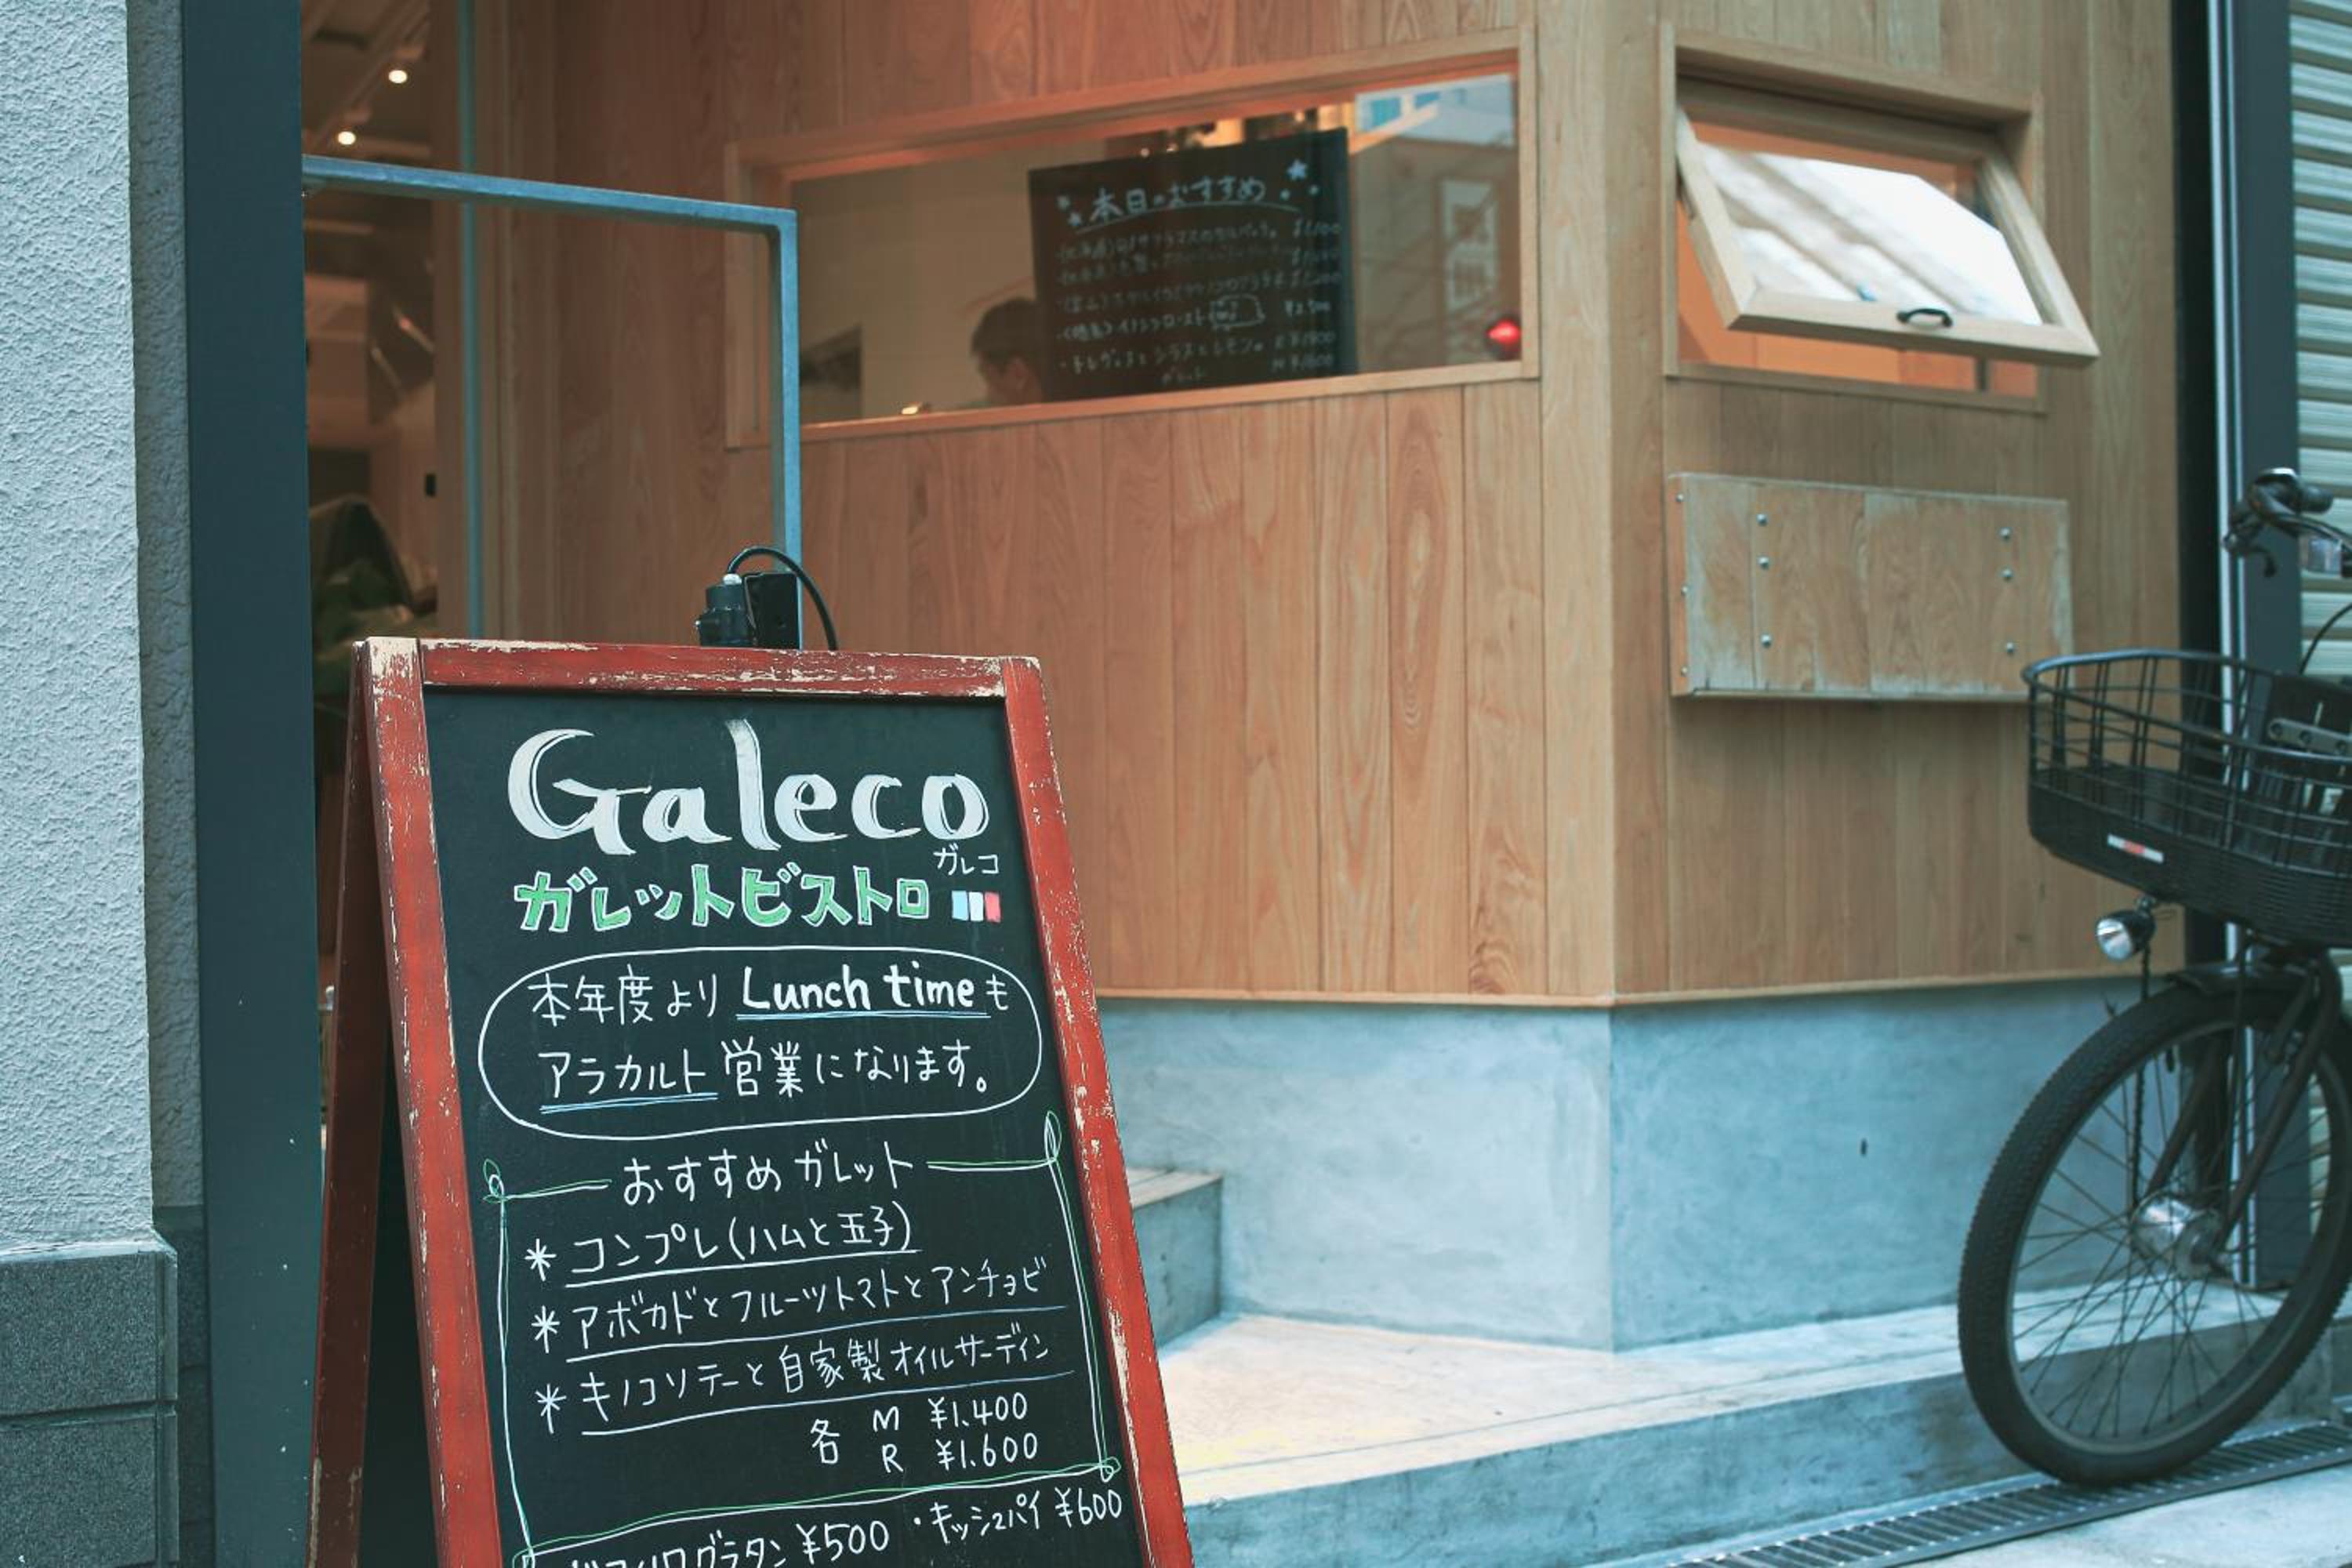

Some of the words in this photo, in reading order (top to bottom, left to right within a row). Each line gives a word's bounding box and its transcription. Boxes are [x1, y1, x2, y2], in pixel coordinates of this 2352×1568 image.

[507, 718, 989, 855] Galeco
[933, 844, 1000, 877] ガレコ
[514, 862, 930, 932] ガレットビストロ
[527, 964, 717, 1027] 本年度より
[742, 965, 871, 1011] Lunch
[810, 1417, 839, 1465] 各
[873, 1408, 900, 1432] M
[883, 1443, 904, 1473] R
[1054, 1487, 1122, 1528] ¥600
[795, 1520, 890, 1565] ¥500
